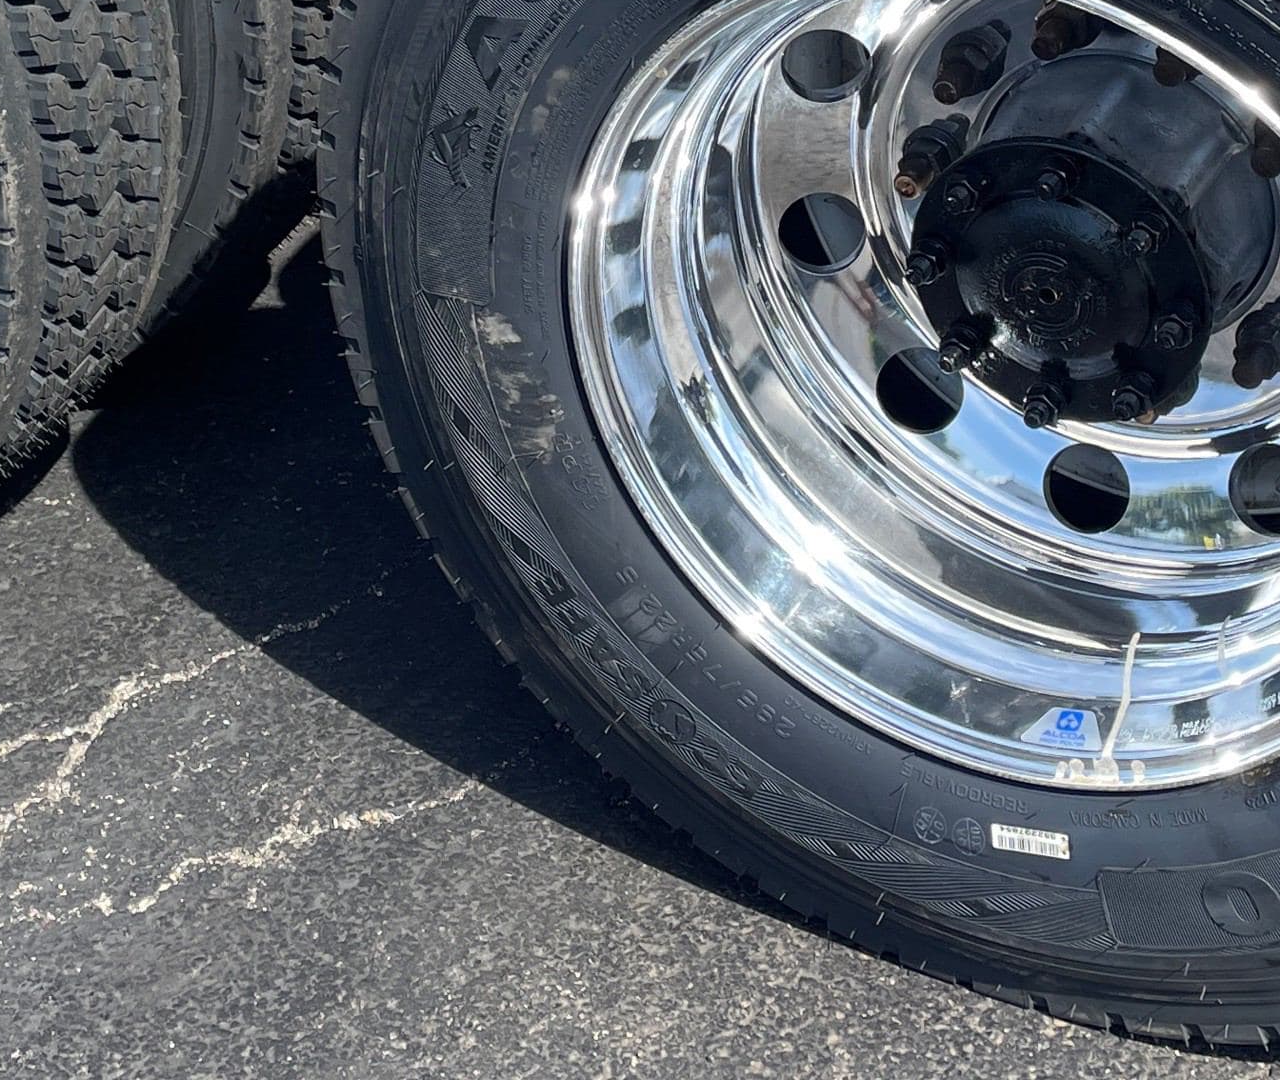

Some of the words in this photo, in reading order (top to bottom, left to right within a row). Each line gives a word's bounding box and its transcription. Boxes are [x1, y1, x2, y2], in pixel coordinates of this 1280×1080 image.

[478, 81, 523, 176] AMERICAN
[1042, 728, 1087, 741] ALCOA
[898, 759, 1028, 815] REGROOVABLE
[1166, 805, 1211, 827] MADE
